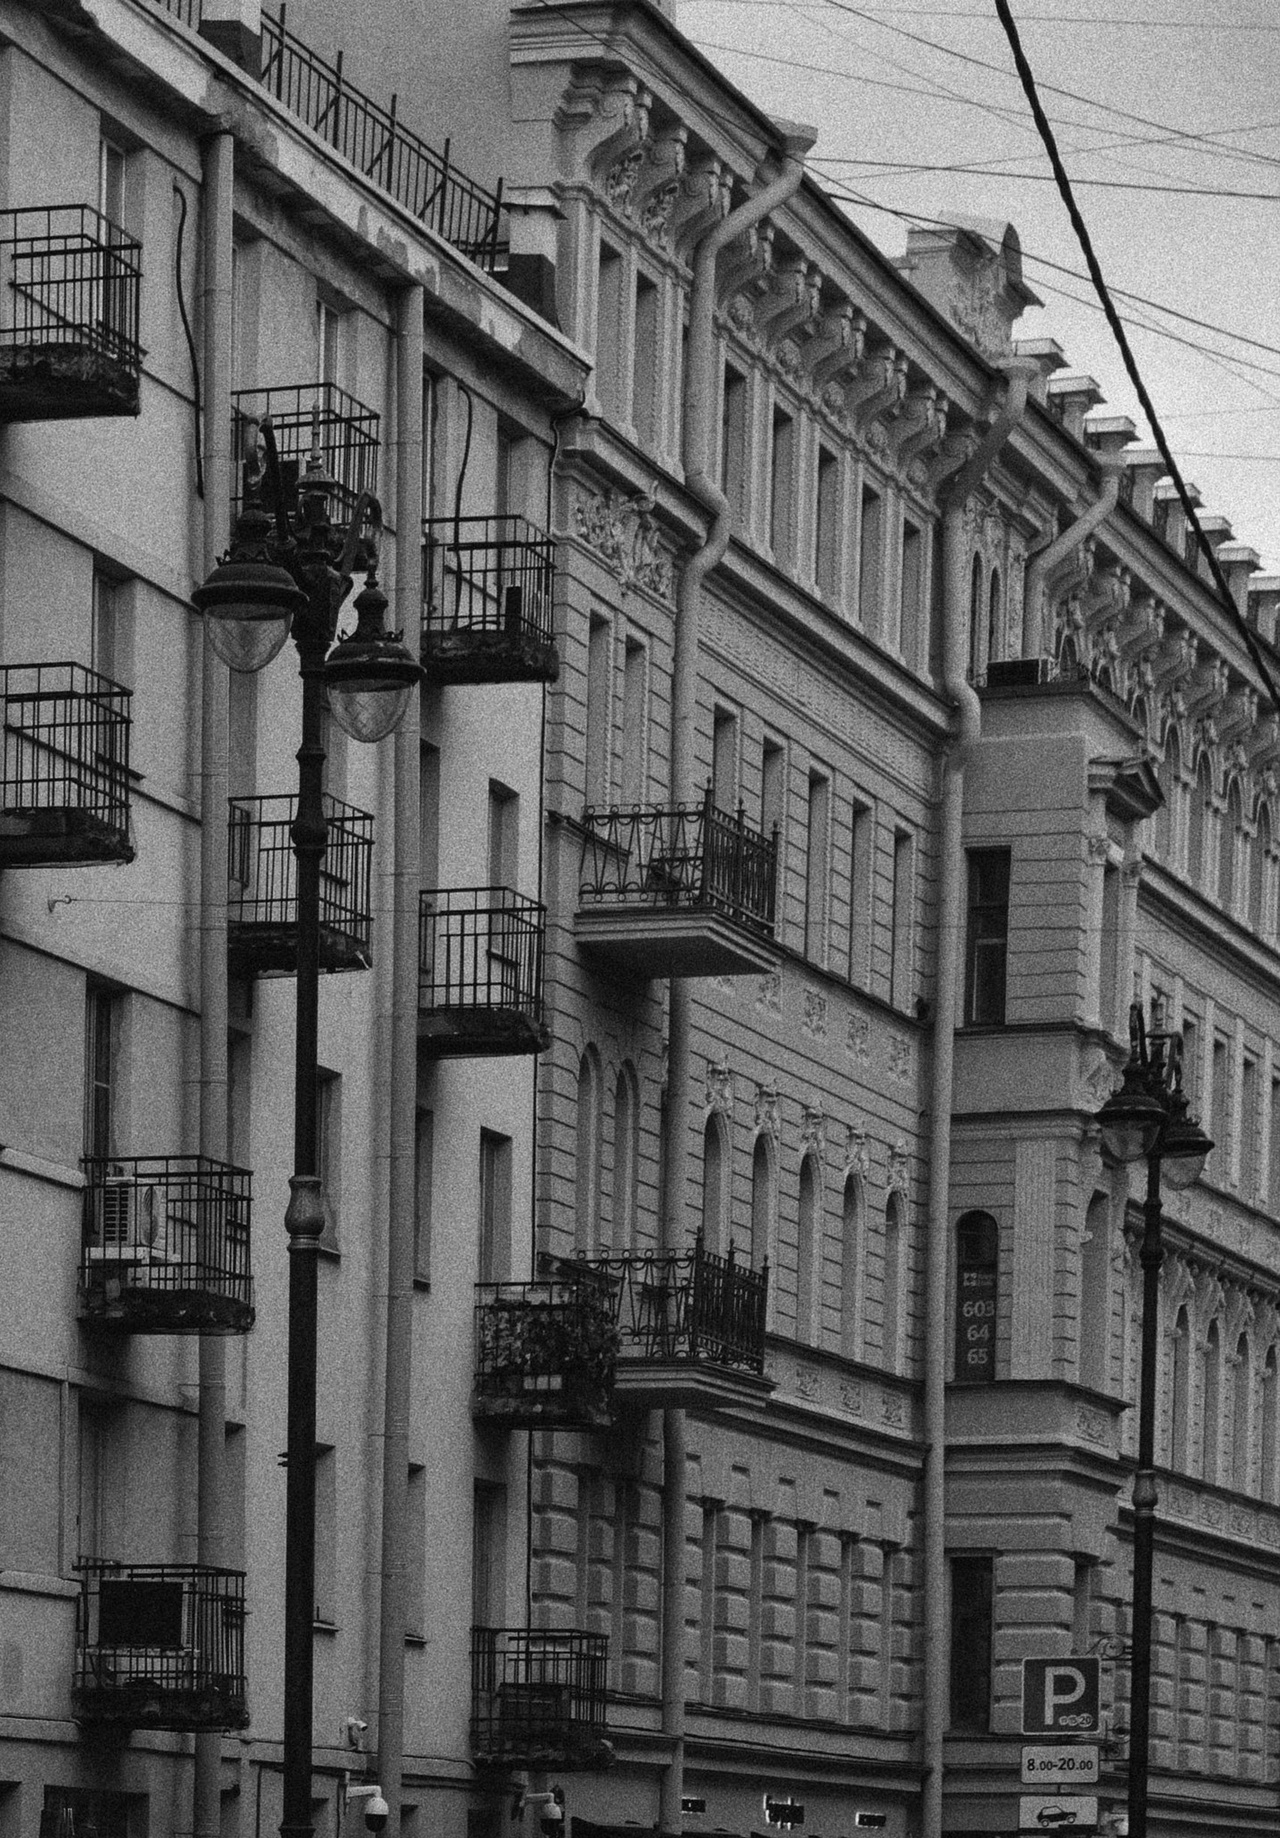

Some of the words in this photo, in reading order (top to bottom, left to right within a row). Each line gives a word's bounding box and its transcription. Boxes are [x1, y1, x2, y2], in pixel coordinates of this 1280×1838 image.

[963, 1300, 995, 1317] 603
[967, 1324, 990, 1342] 64
[967, 1348, 988, 1365] 65
[1044, 1666, 1086, 1725] P
[1027, 1758, 1093, 1771] 8.00-20.00
